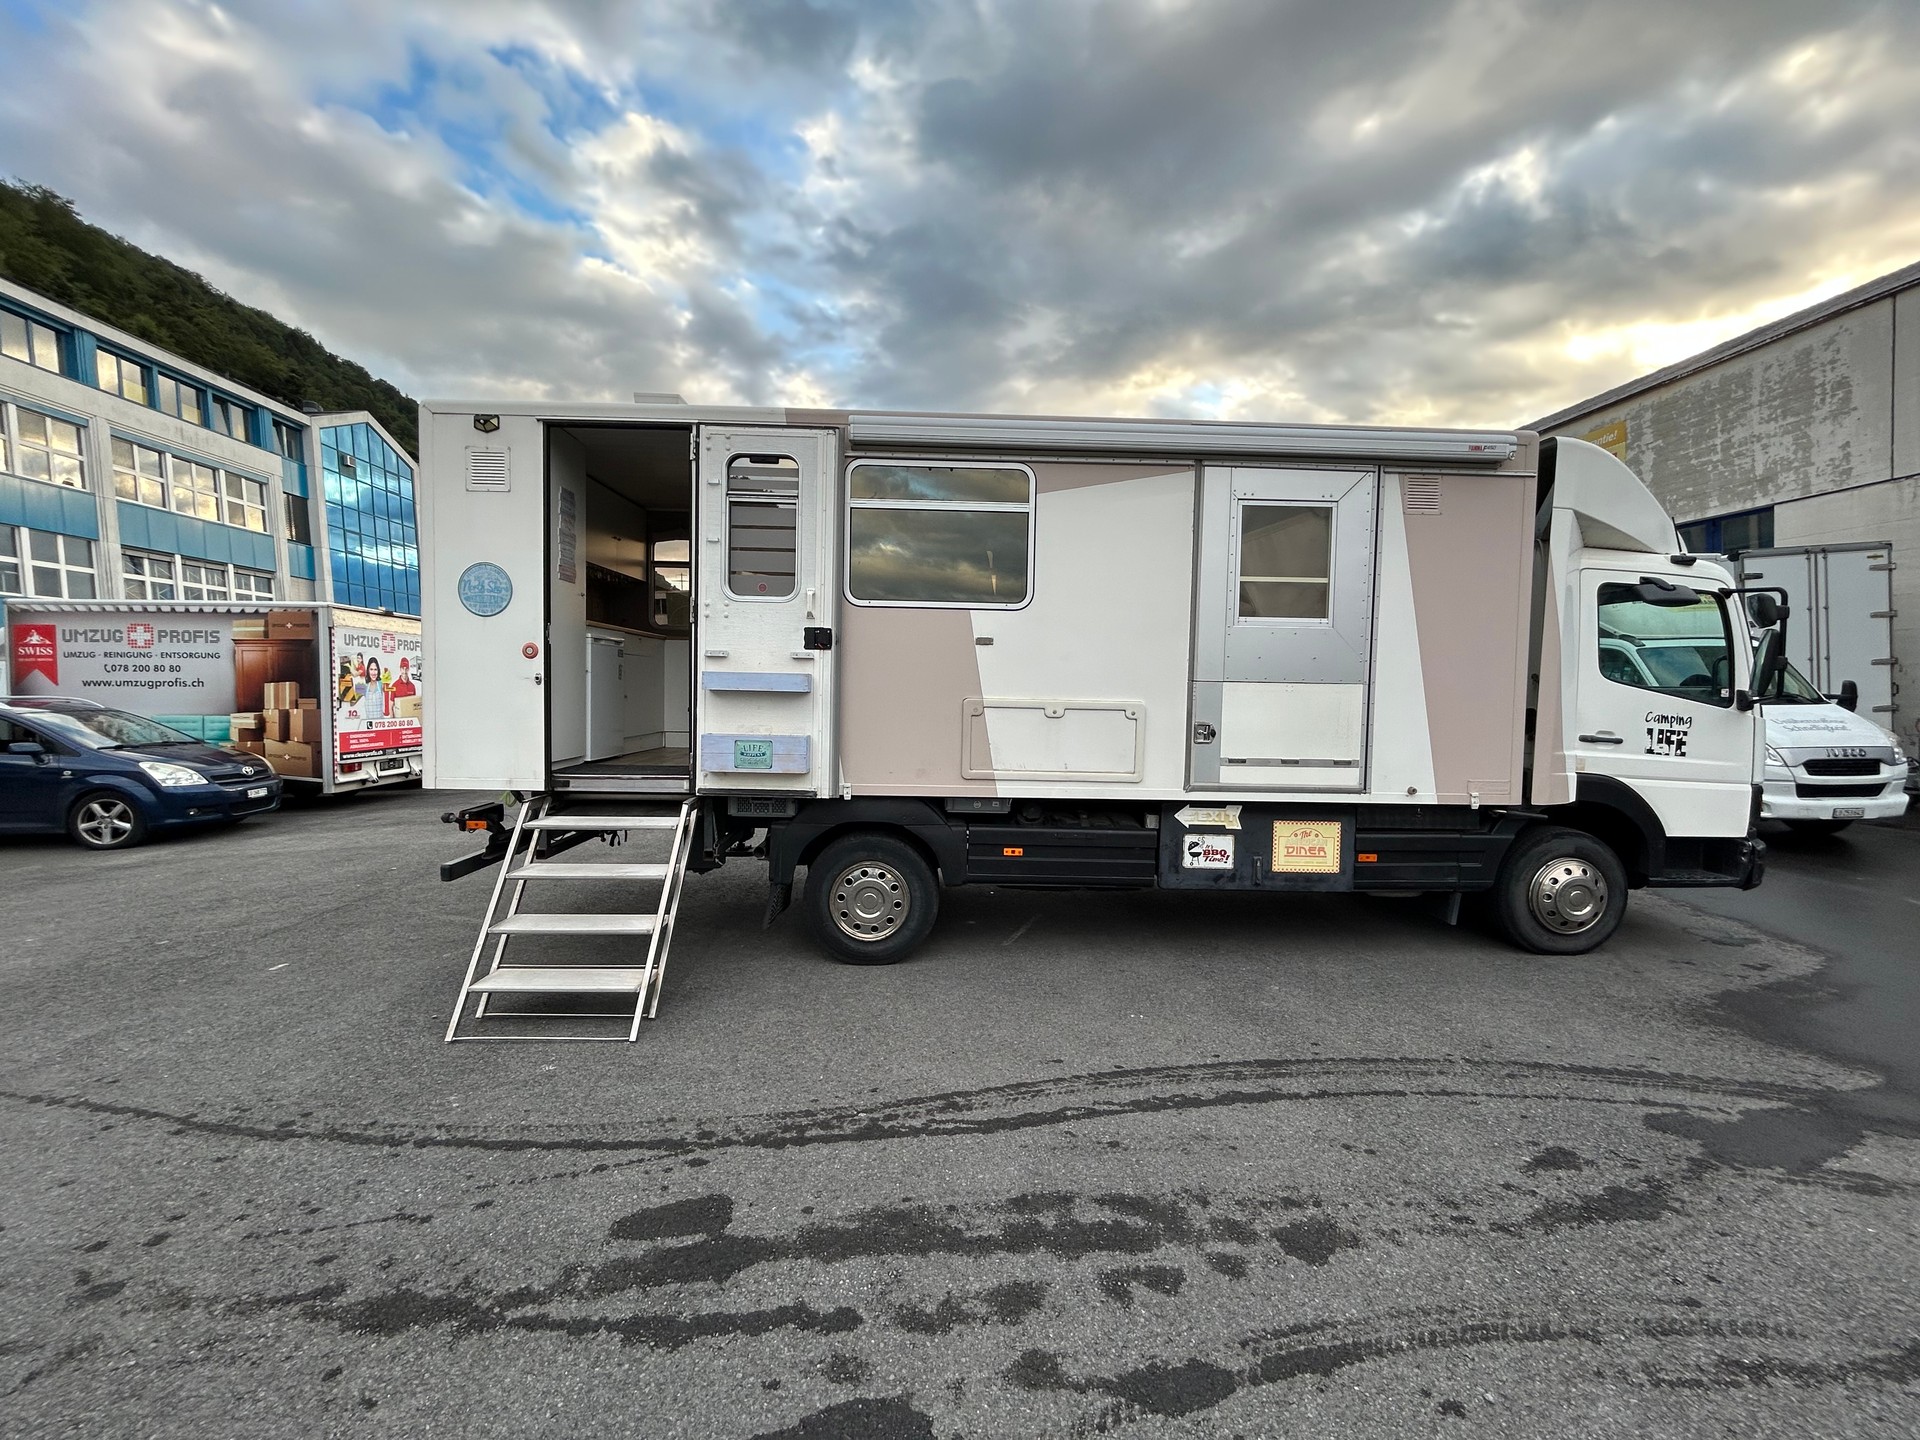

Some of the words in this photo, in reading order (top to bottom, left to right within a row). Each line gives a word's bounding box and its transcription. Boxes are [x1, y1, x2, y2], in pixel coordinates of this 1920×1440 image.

[62, 629, 124, 643] UMZUG
[157, 629, 221, 644] PROFIS
[344, 634, 380, 649] UMZUG
[18, 646, 54, 656] SWISS
[63, 651, 96, 659] UMZUG
[103, 651, 153, 659] REINIGUNG
[160, 651, 221, 660] ENTSORGUNG
[111, 664, 130, 673] 078
[132, 664, 150, 673] 200
[153, 664, 166, 673] 80
[169, 664, 181, 673] 80
[82, 677, 205, 690] www.umzugprofis.ch
[1645, 711, 1692, 729] Camping
[1825, 748, 1867, 758] IVECO
[1201, 811, 1235, 822] EXIT
[1300, 830, 1312, 840] The
[1203, 849, 1228, 858] BBQ
[1284, 845, 1327, 855] DINER
